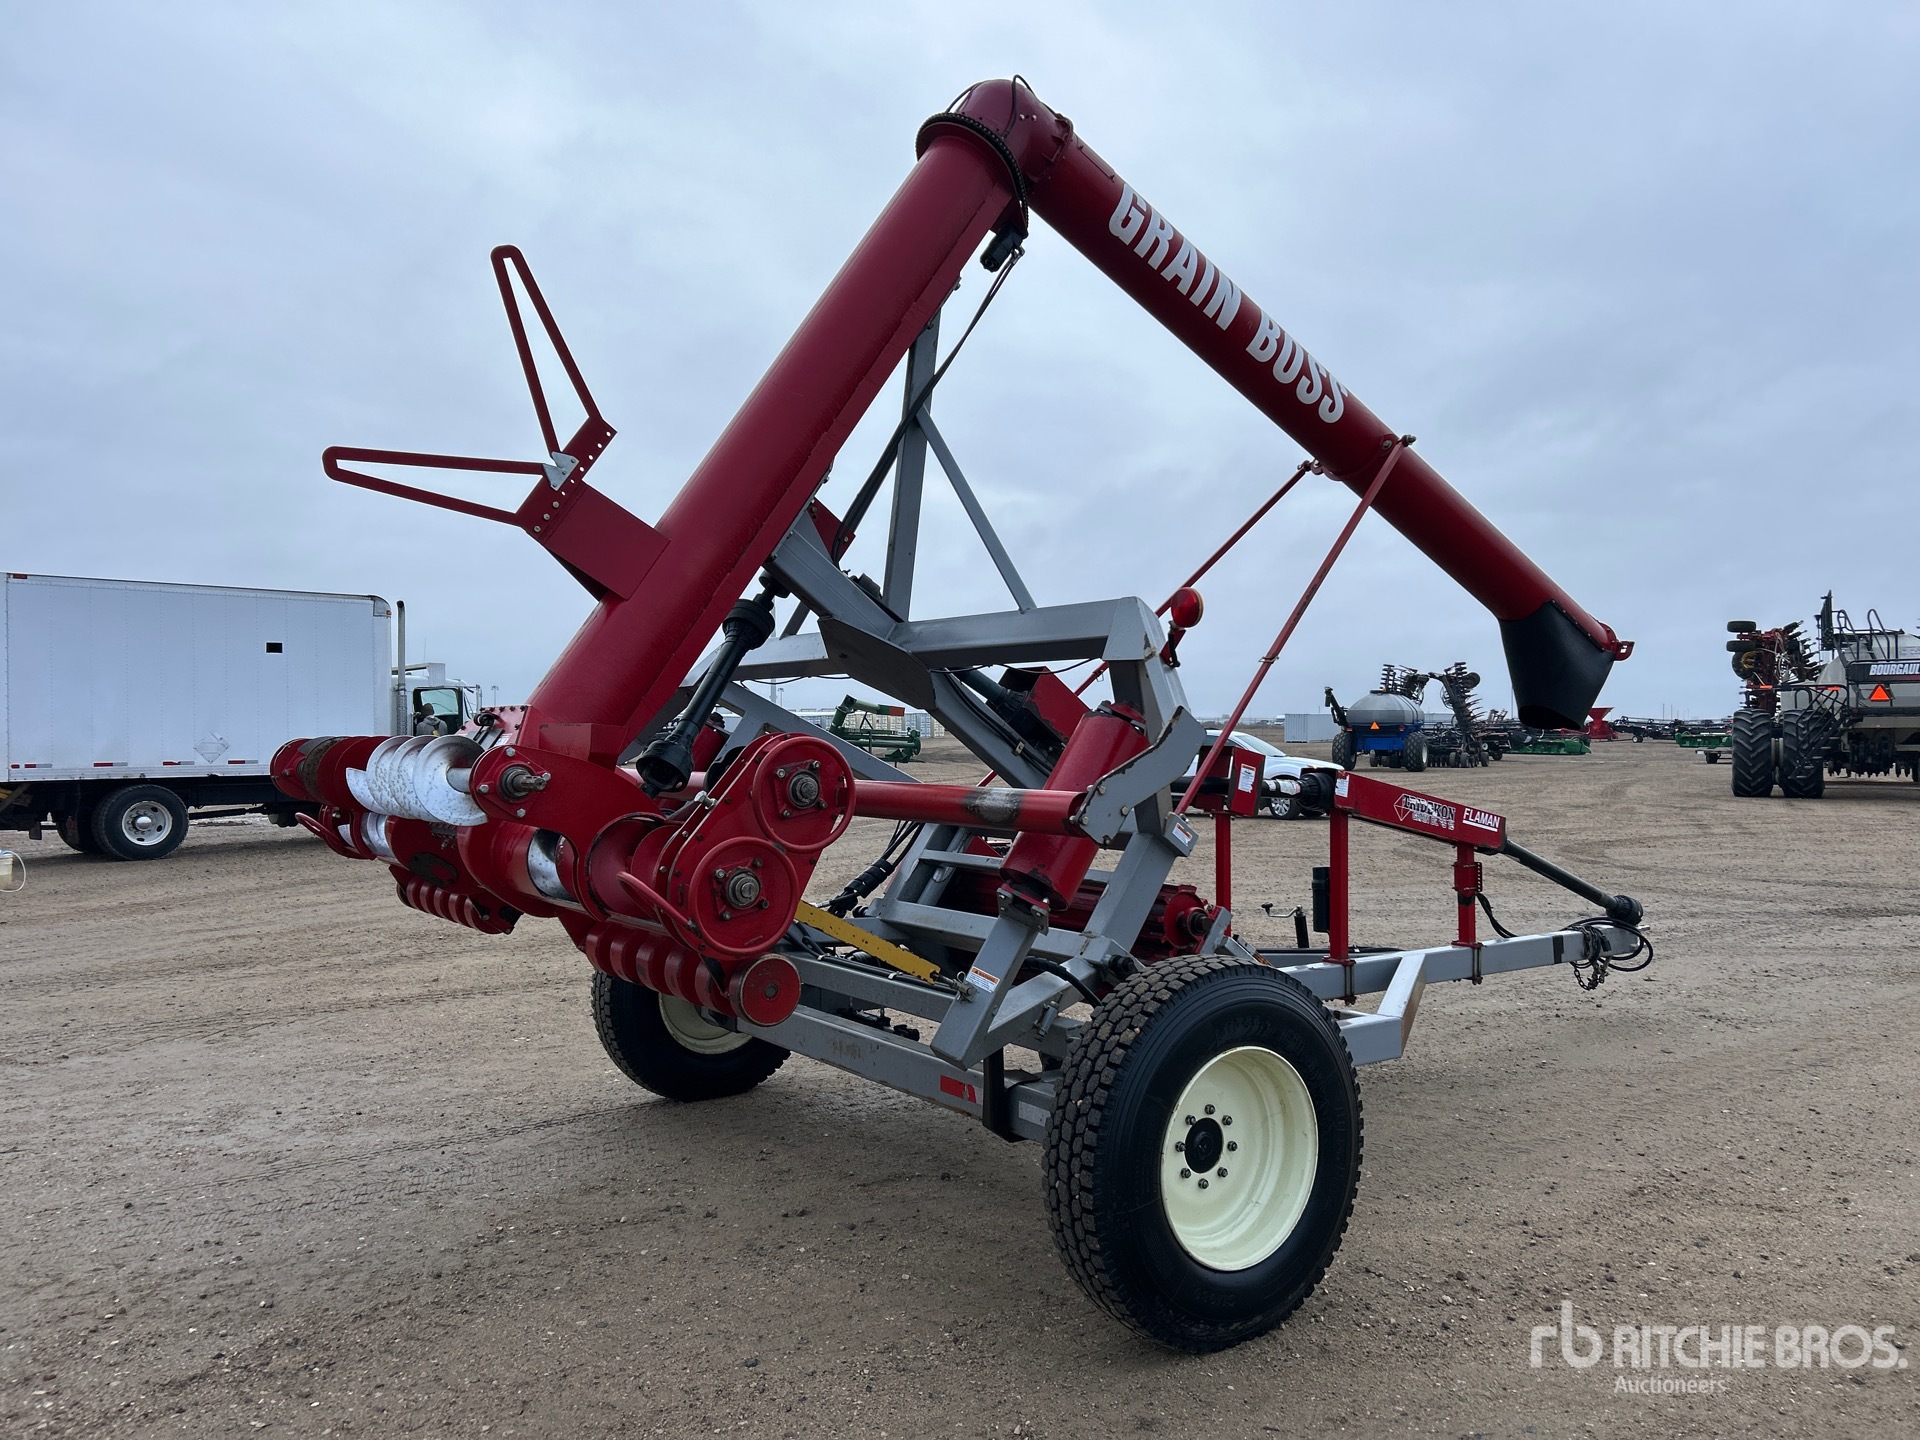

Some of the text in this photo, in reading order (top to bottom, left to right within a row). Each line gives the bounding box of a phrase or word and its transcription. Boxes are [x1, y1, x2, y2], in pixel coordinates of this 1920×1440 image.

[1108, 183, 1349, 423] GRAIN BOSS
[1463, 808, 1500, 829] FLAMAN
